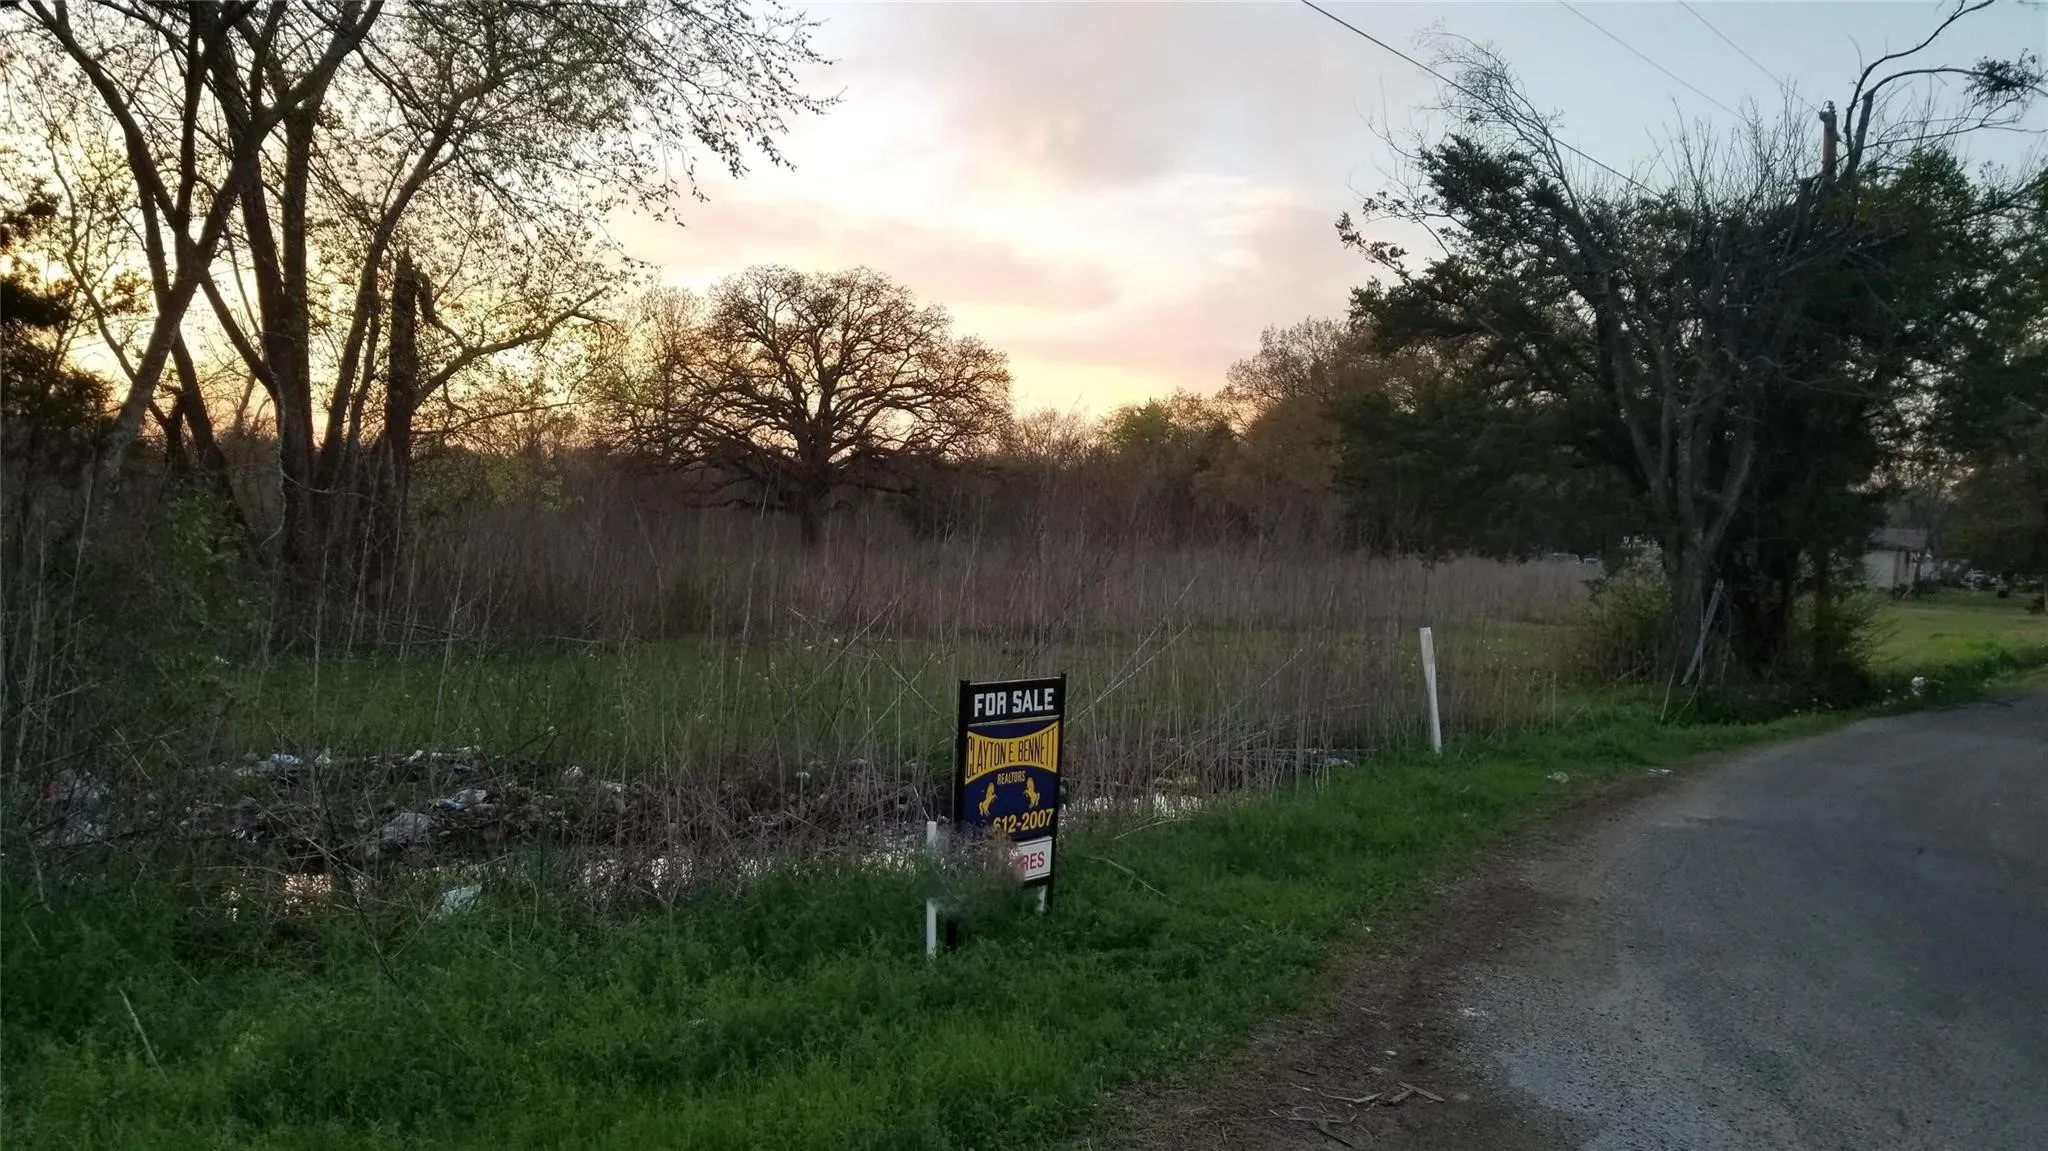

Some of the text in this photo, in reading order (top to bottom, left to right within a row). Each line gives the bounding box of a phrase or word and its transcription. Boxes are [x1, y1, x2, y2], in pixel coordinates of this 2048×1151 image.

[974, 687, 1055, 718] FOR SALE
[966, 735, 1006, 778] CLAYTON
[1018, 725, 1057, 768] BENNETT
[997, 770, 1027, 785] REALTORS
